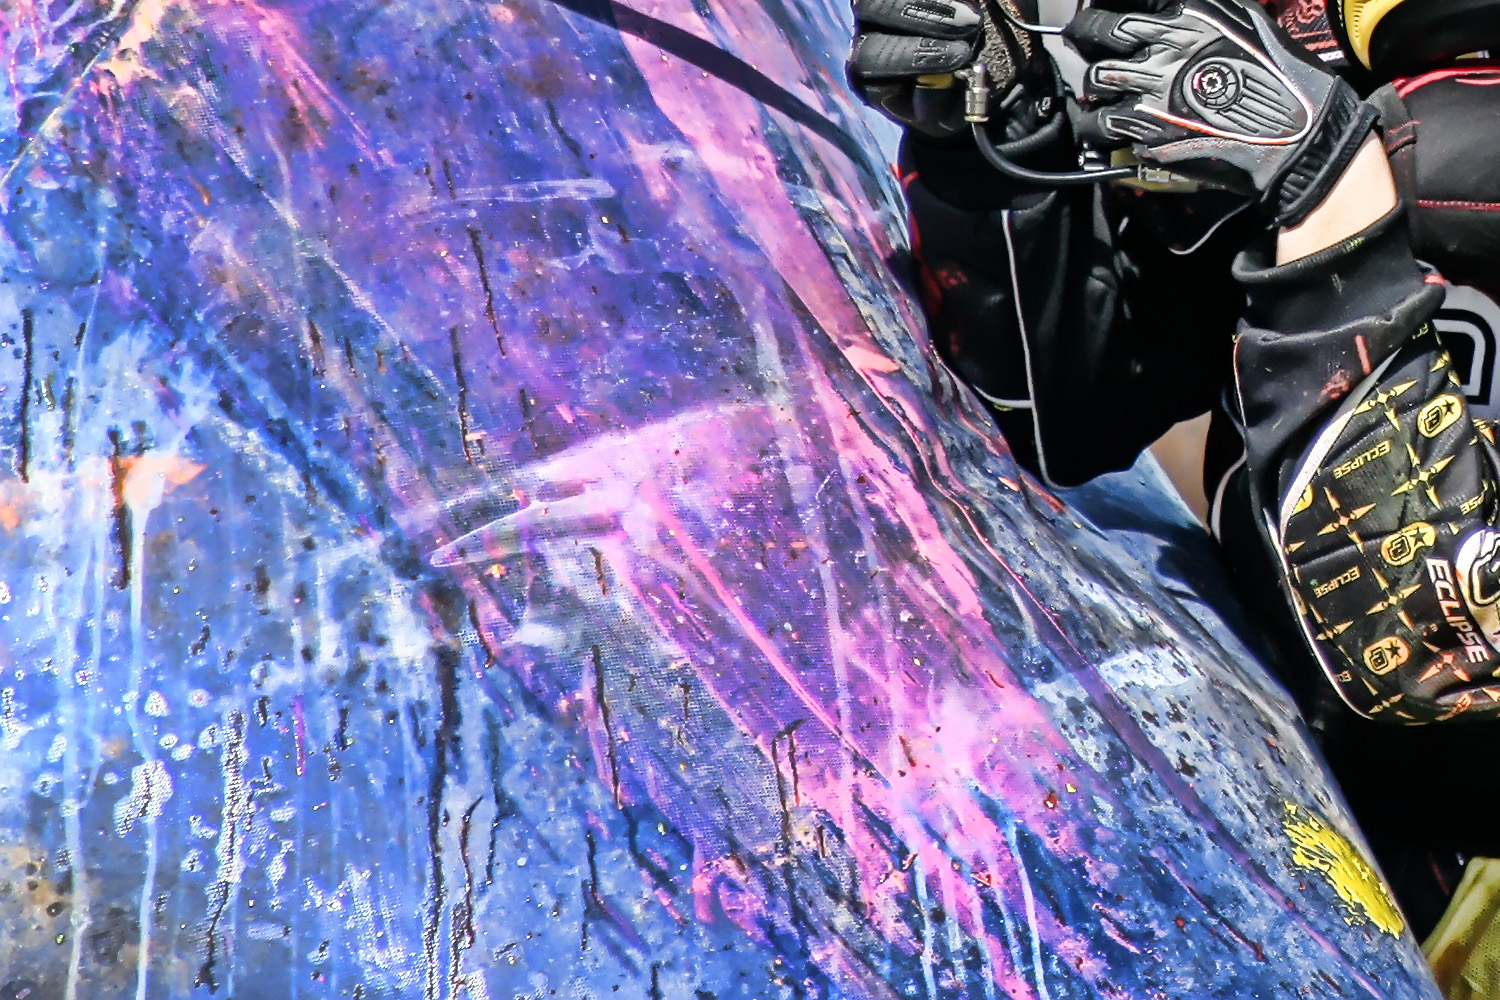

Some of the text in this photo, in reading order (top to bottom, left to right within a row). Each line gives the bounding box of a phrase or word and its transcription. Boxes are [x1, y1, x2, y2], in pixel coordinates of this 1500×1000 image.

[1332, 440, 1392, 479] ECLIPSE
[1313, 565, 1361, 598] ECLIPSE
[1425, 557, 1491, 664] ECLIPSE
